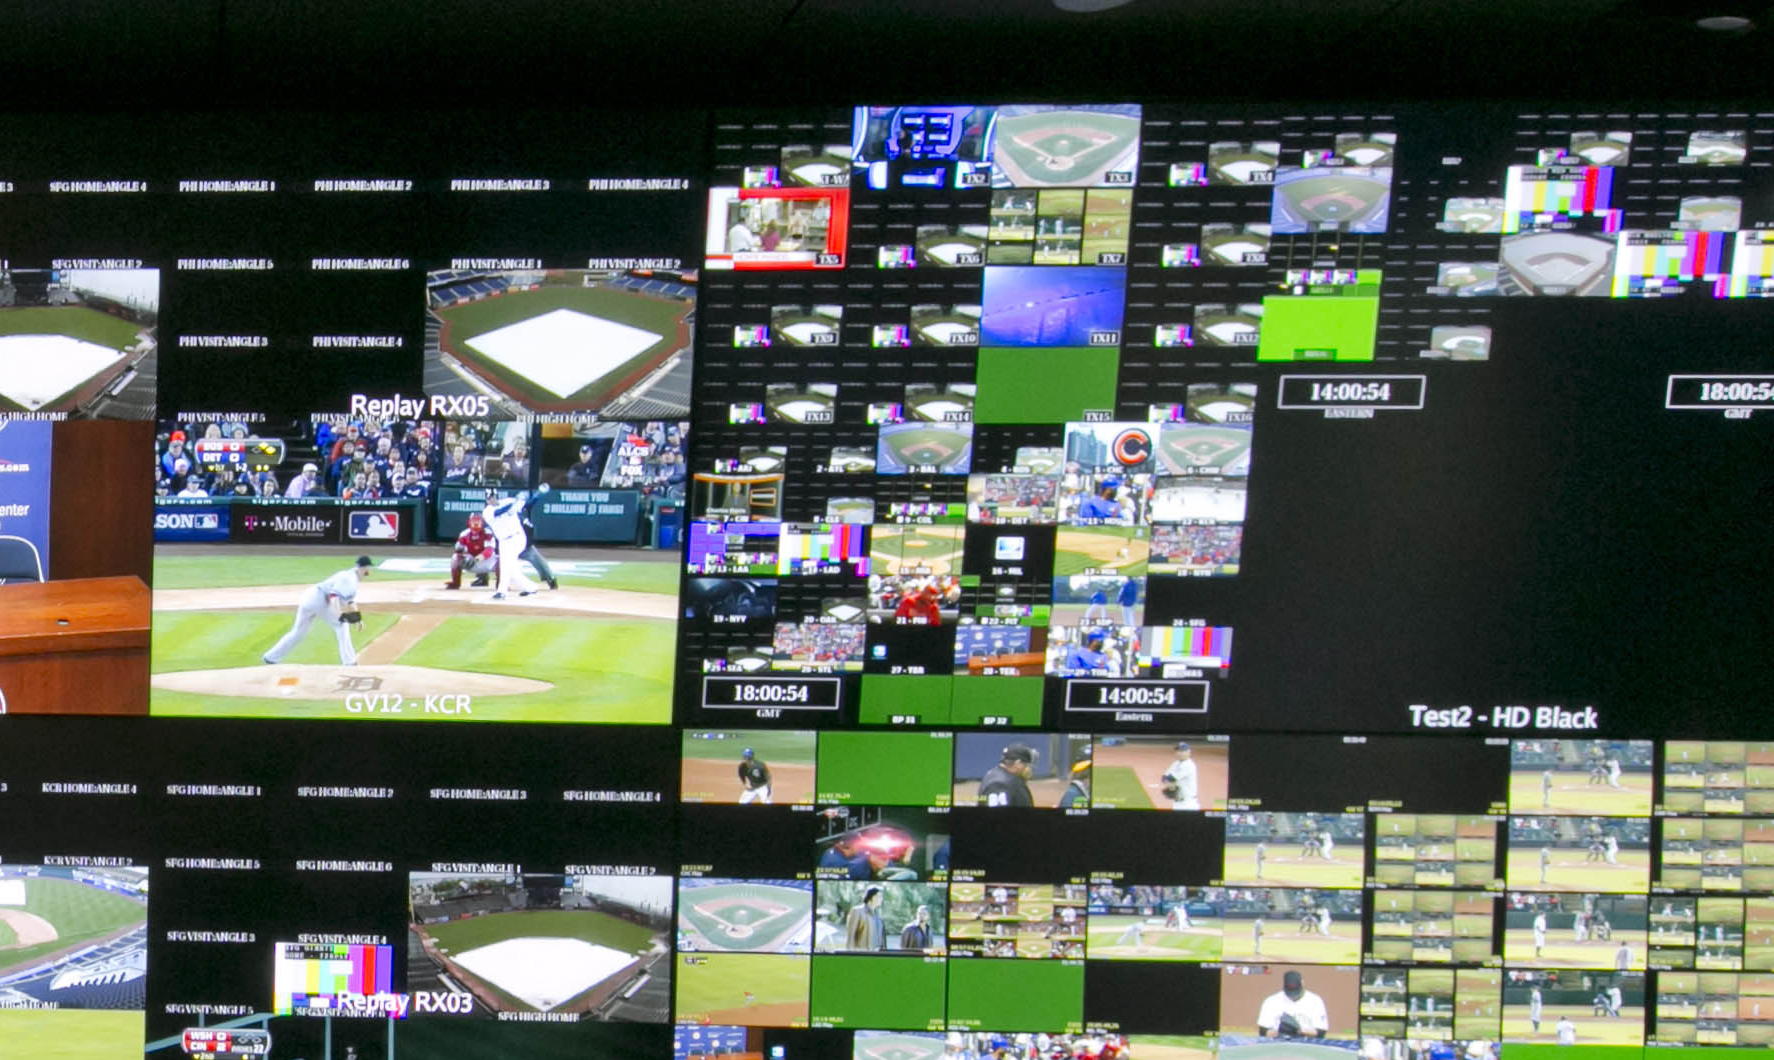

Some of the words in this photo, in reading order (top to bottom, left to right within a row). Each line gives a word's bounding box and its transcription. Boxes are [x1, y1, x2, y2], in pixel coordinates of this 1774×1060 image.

[1310, 382, 1390, 402] 14:00:54
[352, 394, 425, 418] Replay
[430, 394, 489, 417] RX05
[620, 466, 643, 476] FOX
[734, 685, 808, 702] 18:00:54
[1099, 687, 1175, 704] 14:00:54
[346, 694, 404, 713] GV12
[425, 695, 472, 714] KCR
[1115, 712, 1153, 721] Eastern
[1409, 704, 1472, 728] Test2
[1492, 706, 1530, 728] HD
[1535, 705, 1598, 729] Black
[337, 990, 409, 1017] Replay
[415, 993, 472, 1015] RX03
